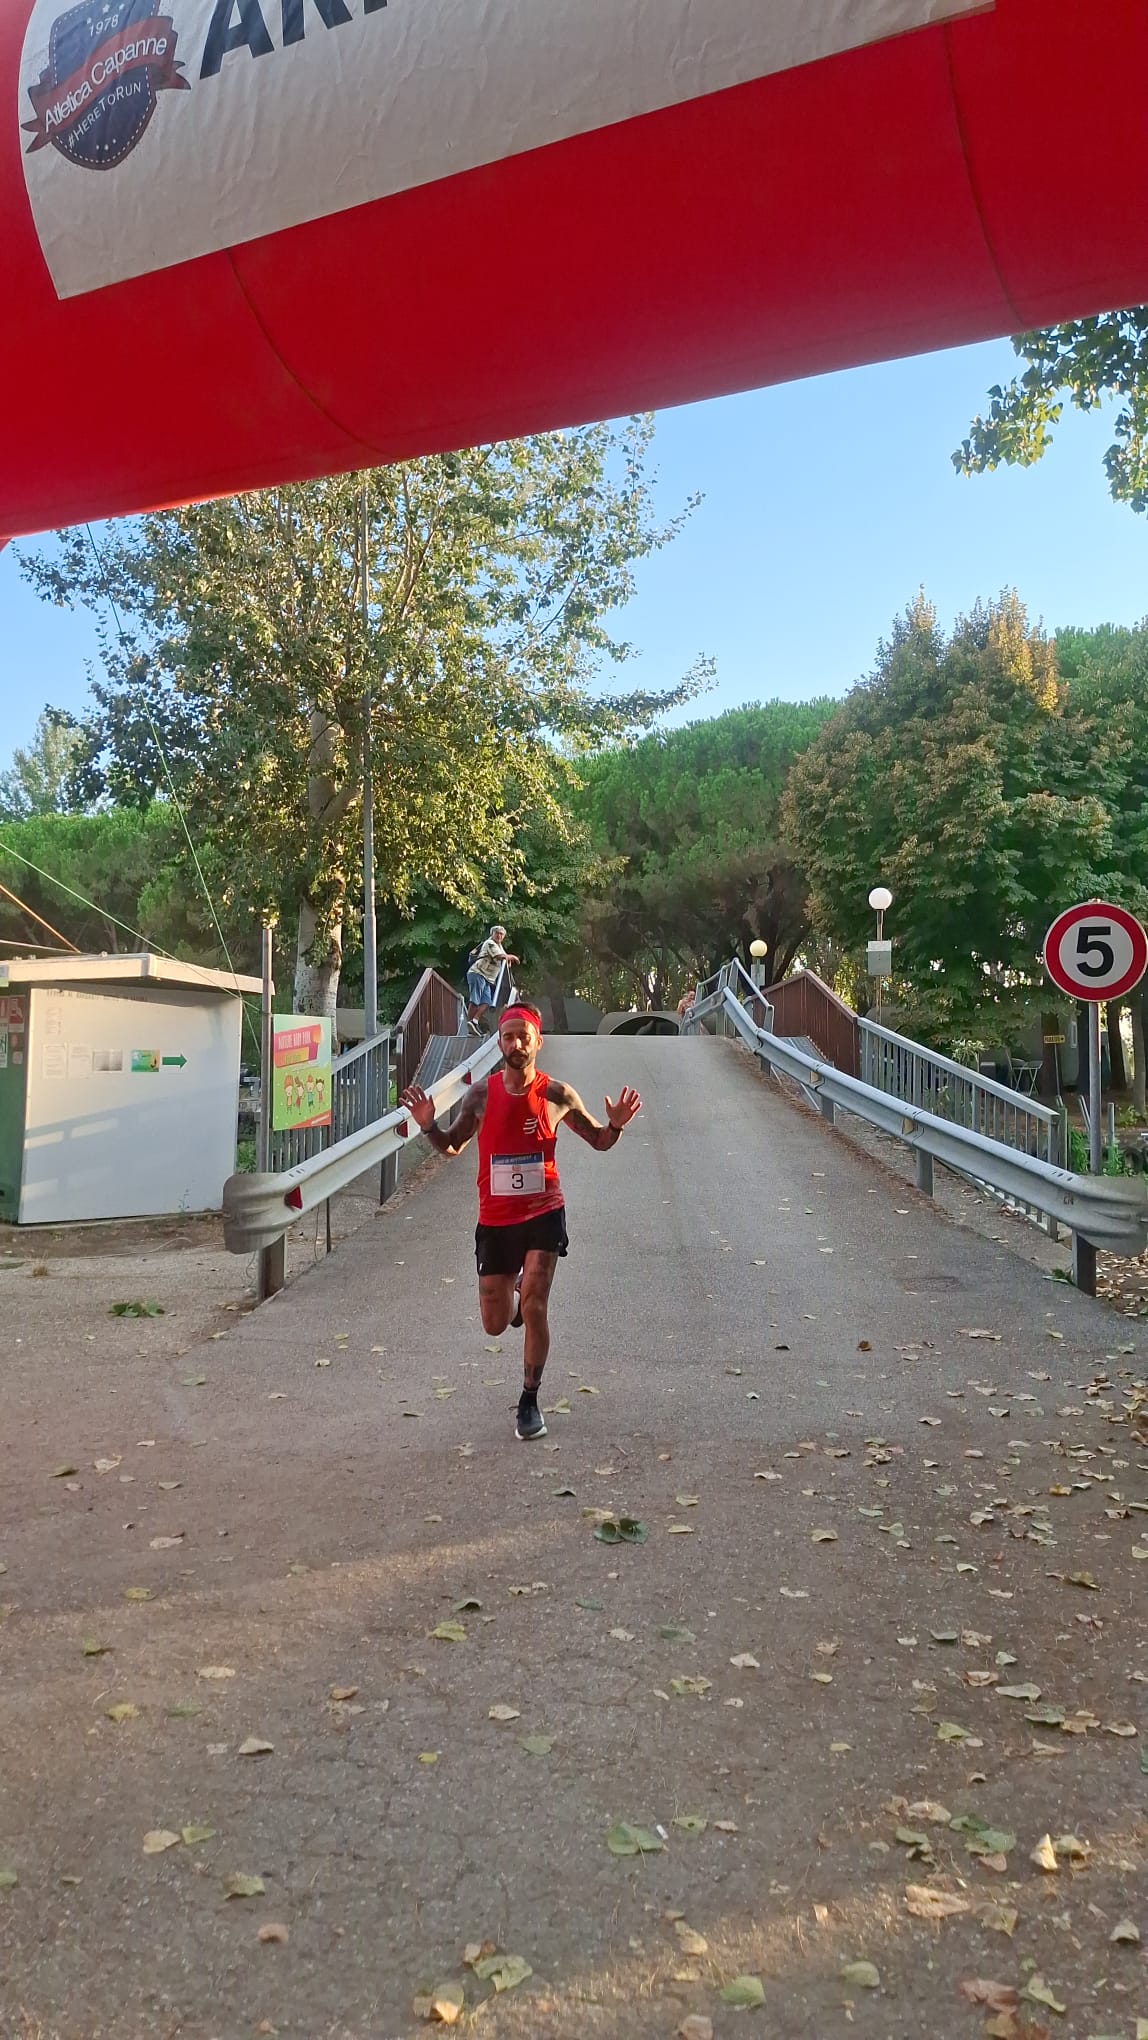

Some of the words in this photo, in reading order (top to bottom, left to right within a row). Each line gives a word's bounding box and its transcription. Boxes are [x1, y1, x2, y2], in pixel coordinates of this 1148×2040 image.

[89, 14, 119, 37] 1978
[45, 81, 93, 133] Atletica
[91, 37, 167, 85] Capanne
[1076, 926, 1115, 977] 5
[511, 1173, 524, 1190] 3
